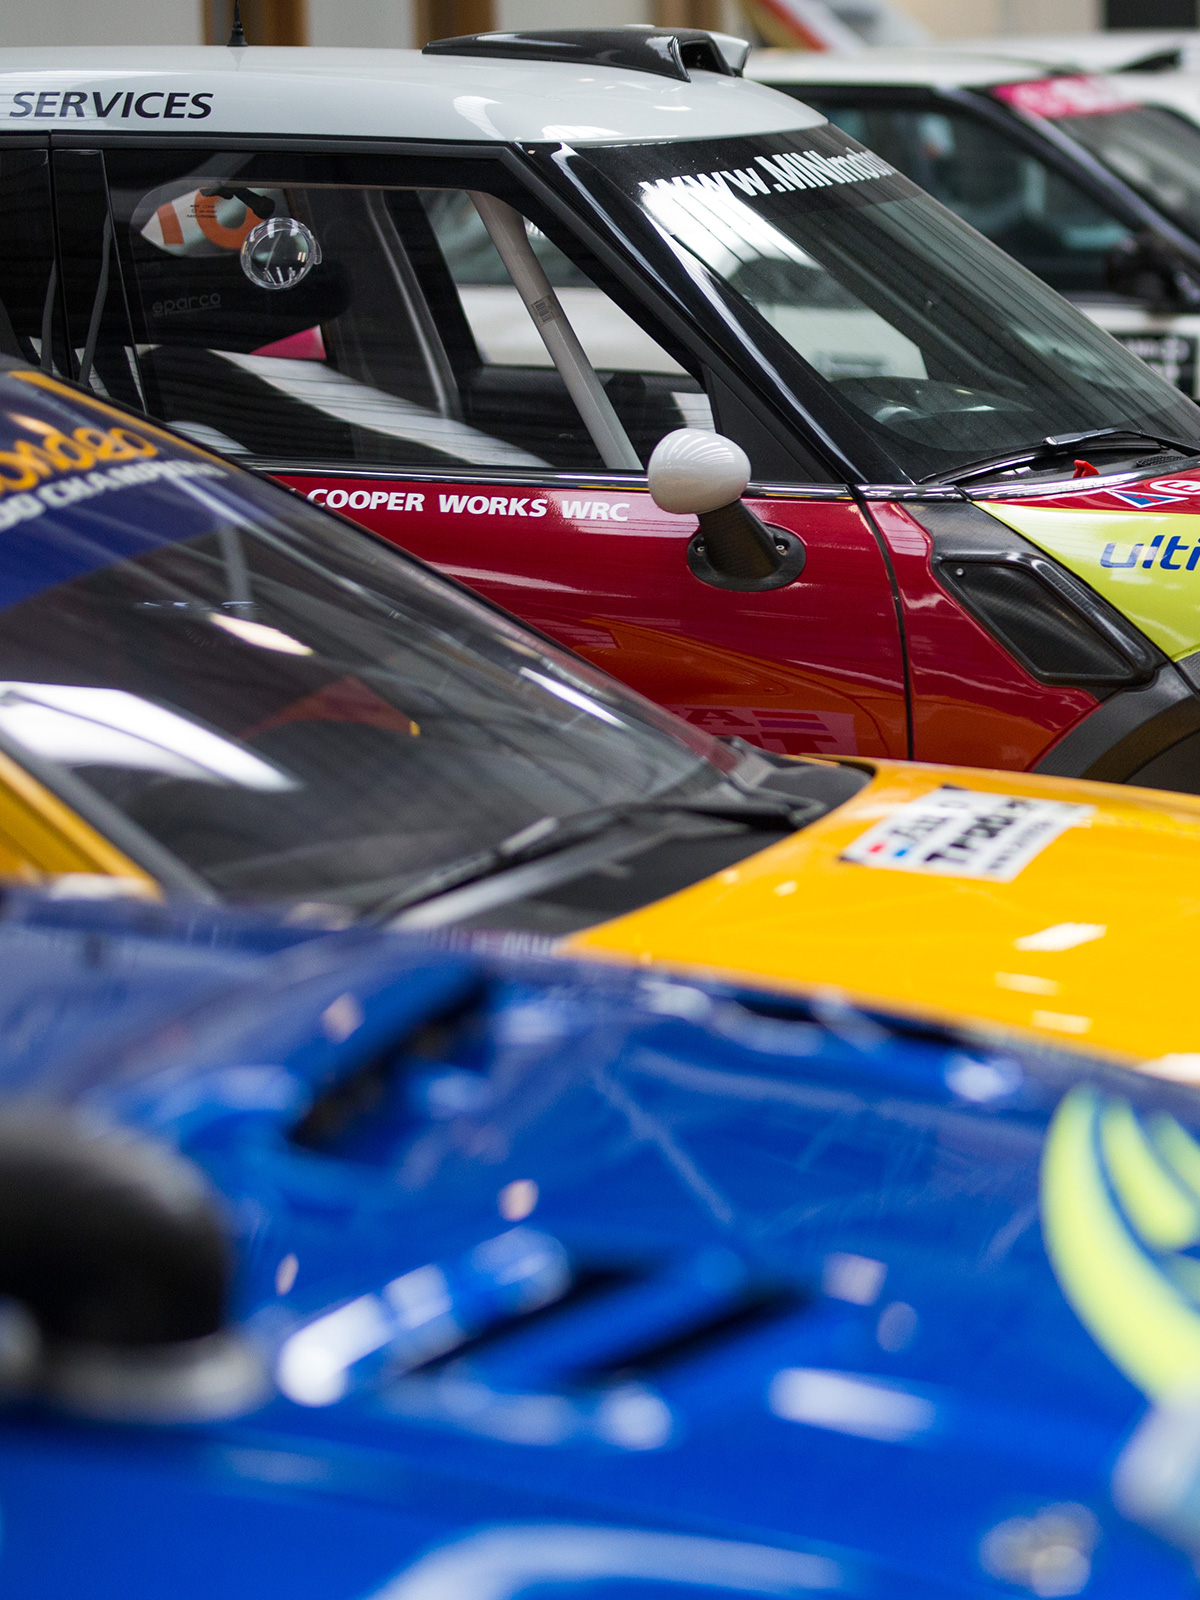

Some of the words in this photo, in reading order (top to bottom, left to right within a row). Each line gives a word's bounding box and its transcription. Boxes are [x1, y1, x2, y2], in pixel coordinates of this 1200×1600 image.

[9, 91, 214, 119] SERVICES
[306, 488, 425, 512] COOPER
[439, 494, 548, 518] WORKS
[562, 500, 630, 522] WRC
